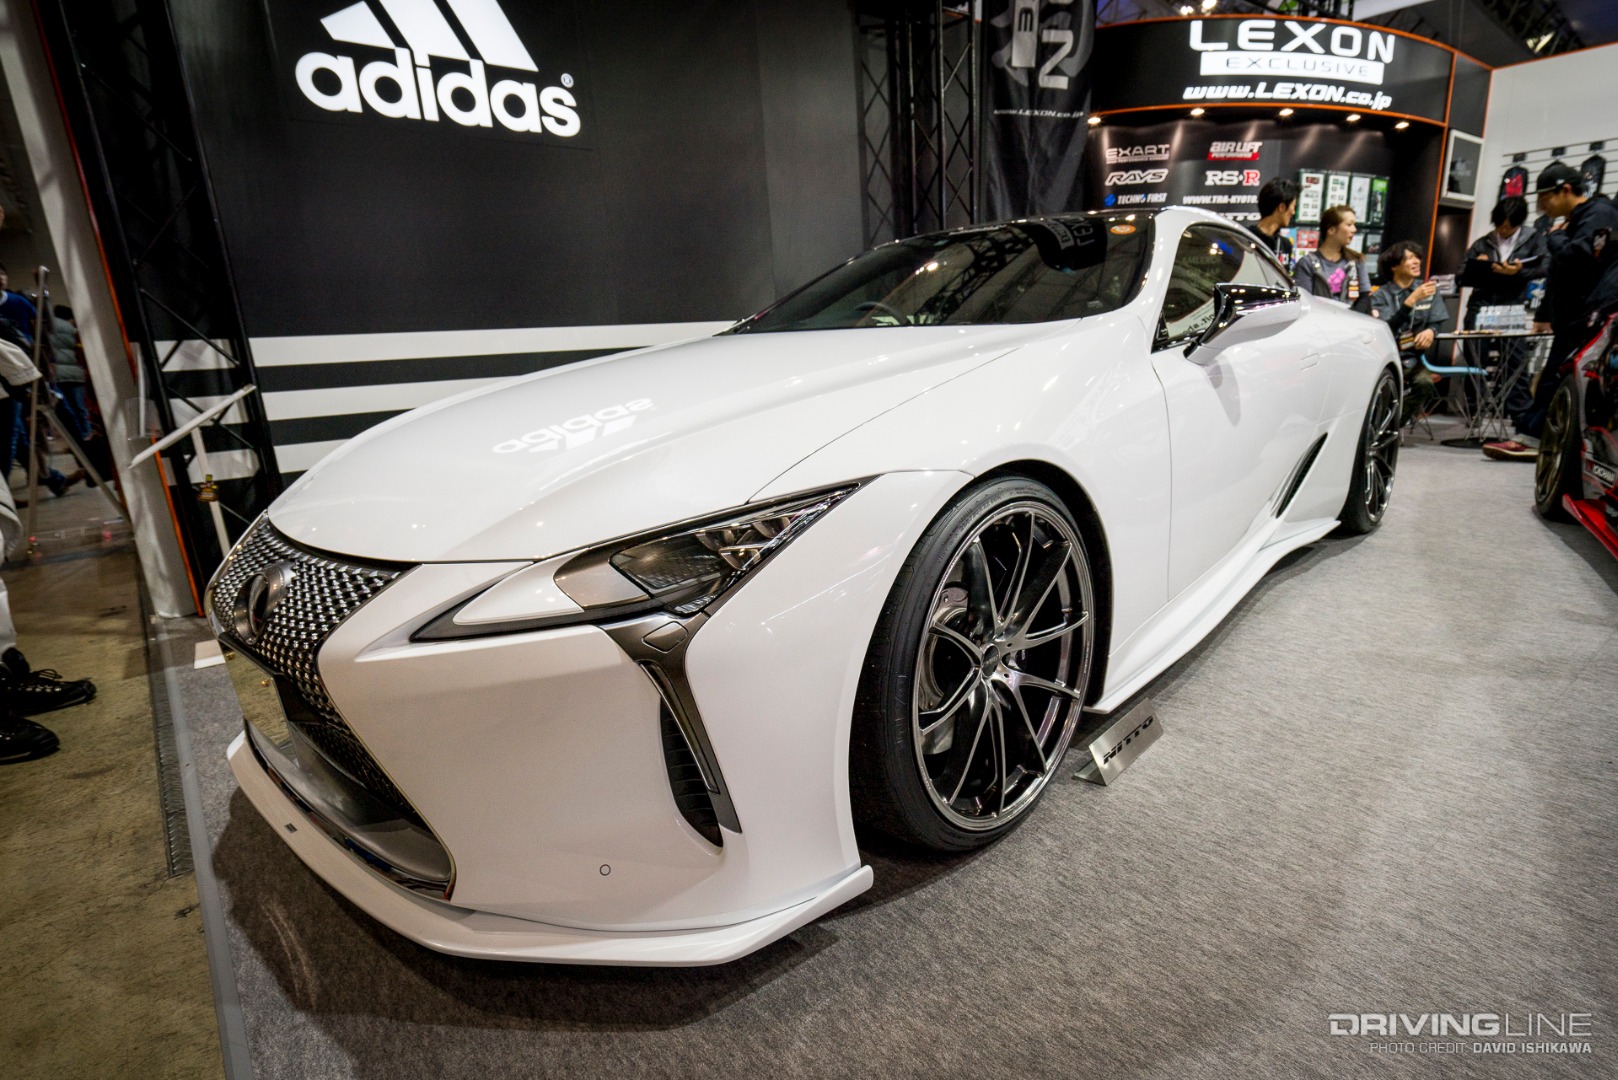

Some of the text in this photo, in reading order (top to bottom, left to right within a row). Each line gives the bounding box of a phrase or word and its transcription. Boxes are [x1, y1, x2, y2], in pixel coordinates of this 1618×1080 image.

[1189, 20, 1395, 64] LEXON
[1226, 57, 1369, 77] EXCLUSIVE
[295, 47, 581, 137] adidas
[1182, 82, 1393, 111] www.LEXON.co.jp
[1105, 144, 1170, 158] EXART
[1105, 168, 1169, 186] RAYS
[1103, 716, 1154, 765] NITTO
